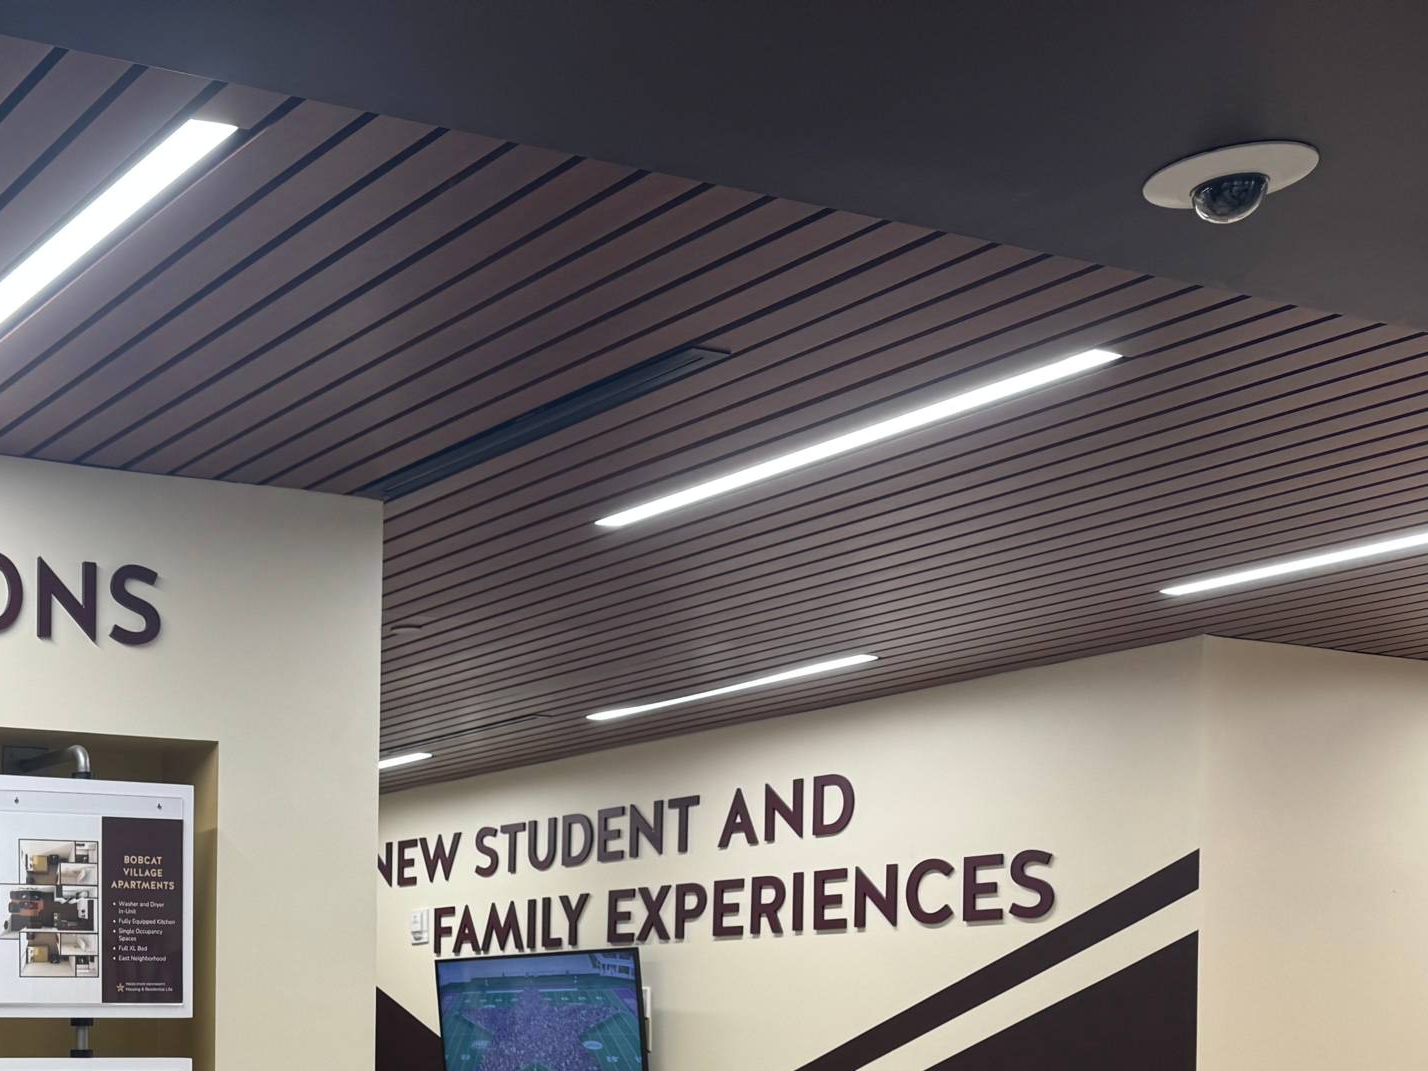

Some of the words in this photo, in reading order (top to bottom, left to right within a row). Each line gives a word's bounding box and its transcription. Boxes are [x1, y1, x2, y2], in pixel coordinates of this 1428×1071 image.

[474, 795, 700, 878] STUDENT
[718, 773, 856, 848] AND
[124, 856, 162, 864] BOBCAT
[124, 868, 163, 877] VILLAGE
[111, 880, 174, 890] APARTMENTS
[433, 891, 591, 956] FAMILY
[606, 848, 1057, 944] EXPERIENCES
